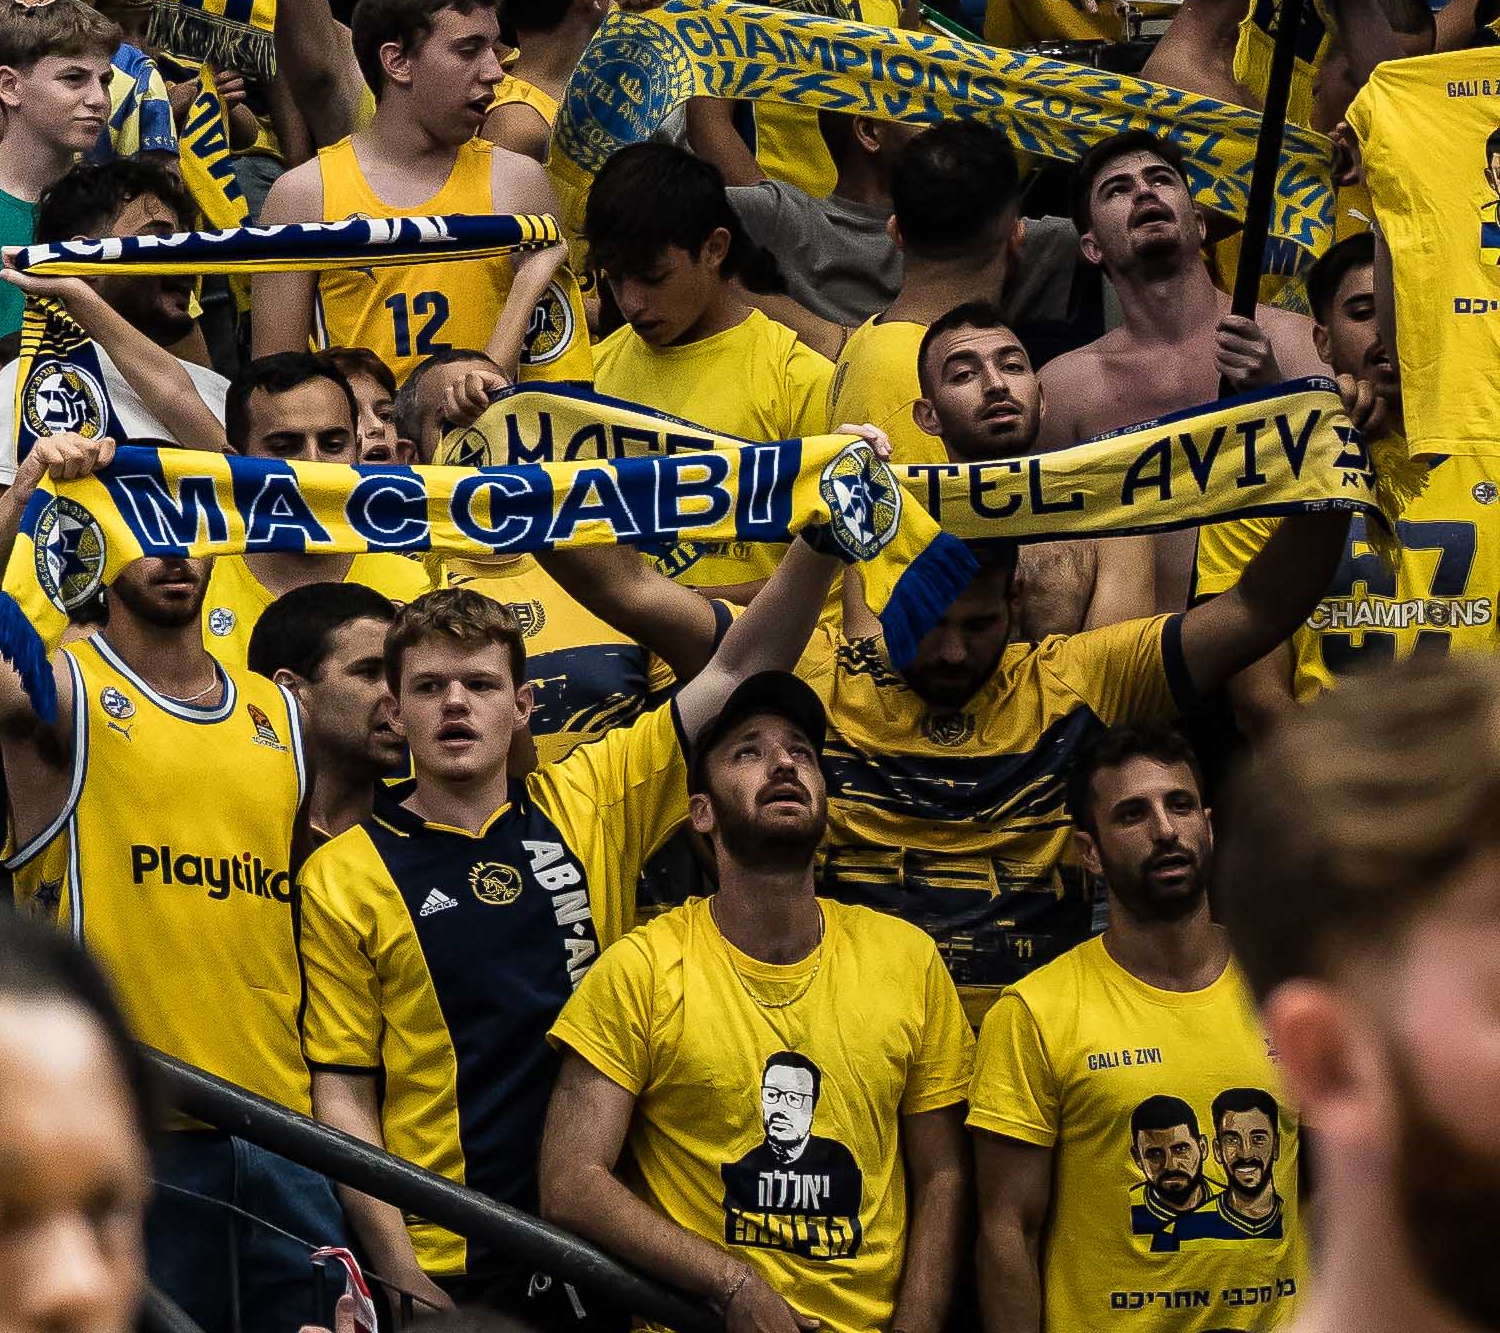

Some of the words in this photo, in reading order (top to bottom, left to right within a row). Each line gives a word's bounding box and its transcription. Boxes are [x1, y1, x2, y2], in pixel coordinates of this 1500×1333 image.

[672, 16, 1007, 108] CHAMPIONS
[384, 291, 452, 356] 12
[116, 440, 783, 555] MACCABI
[908, 462, 1087, 522] TEL
[1120, 409, 1323, 506] AVIV
[1086, 1050, 1120, 1072] GALI
[1133, 1047, 1163, 1068] ZIVI
[1108, 1286, 1212, 1310] אחריכם
[1218, 1282, 1273, 1307] מכבי
